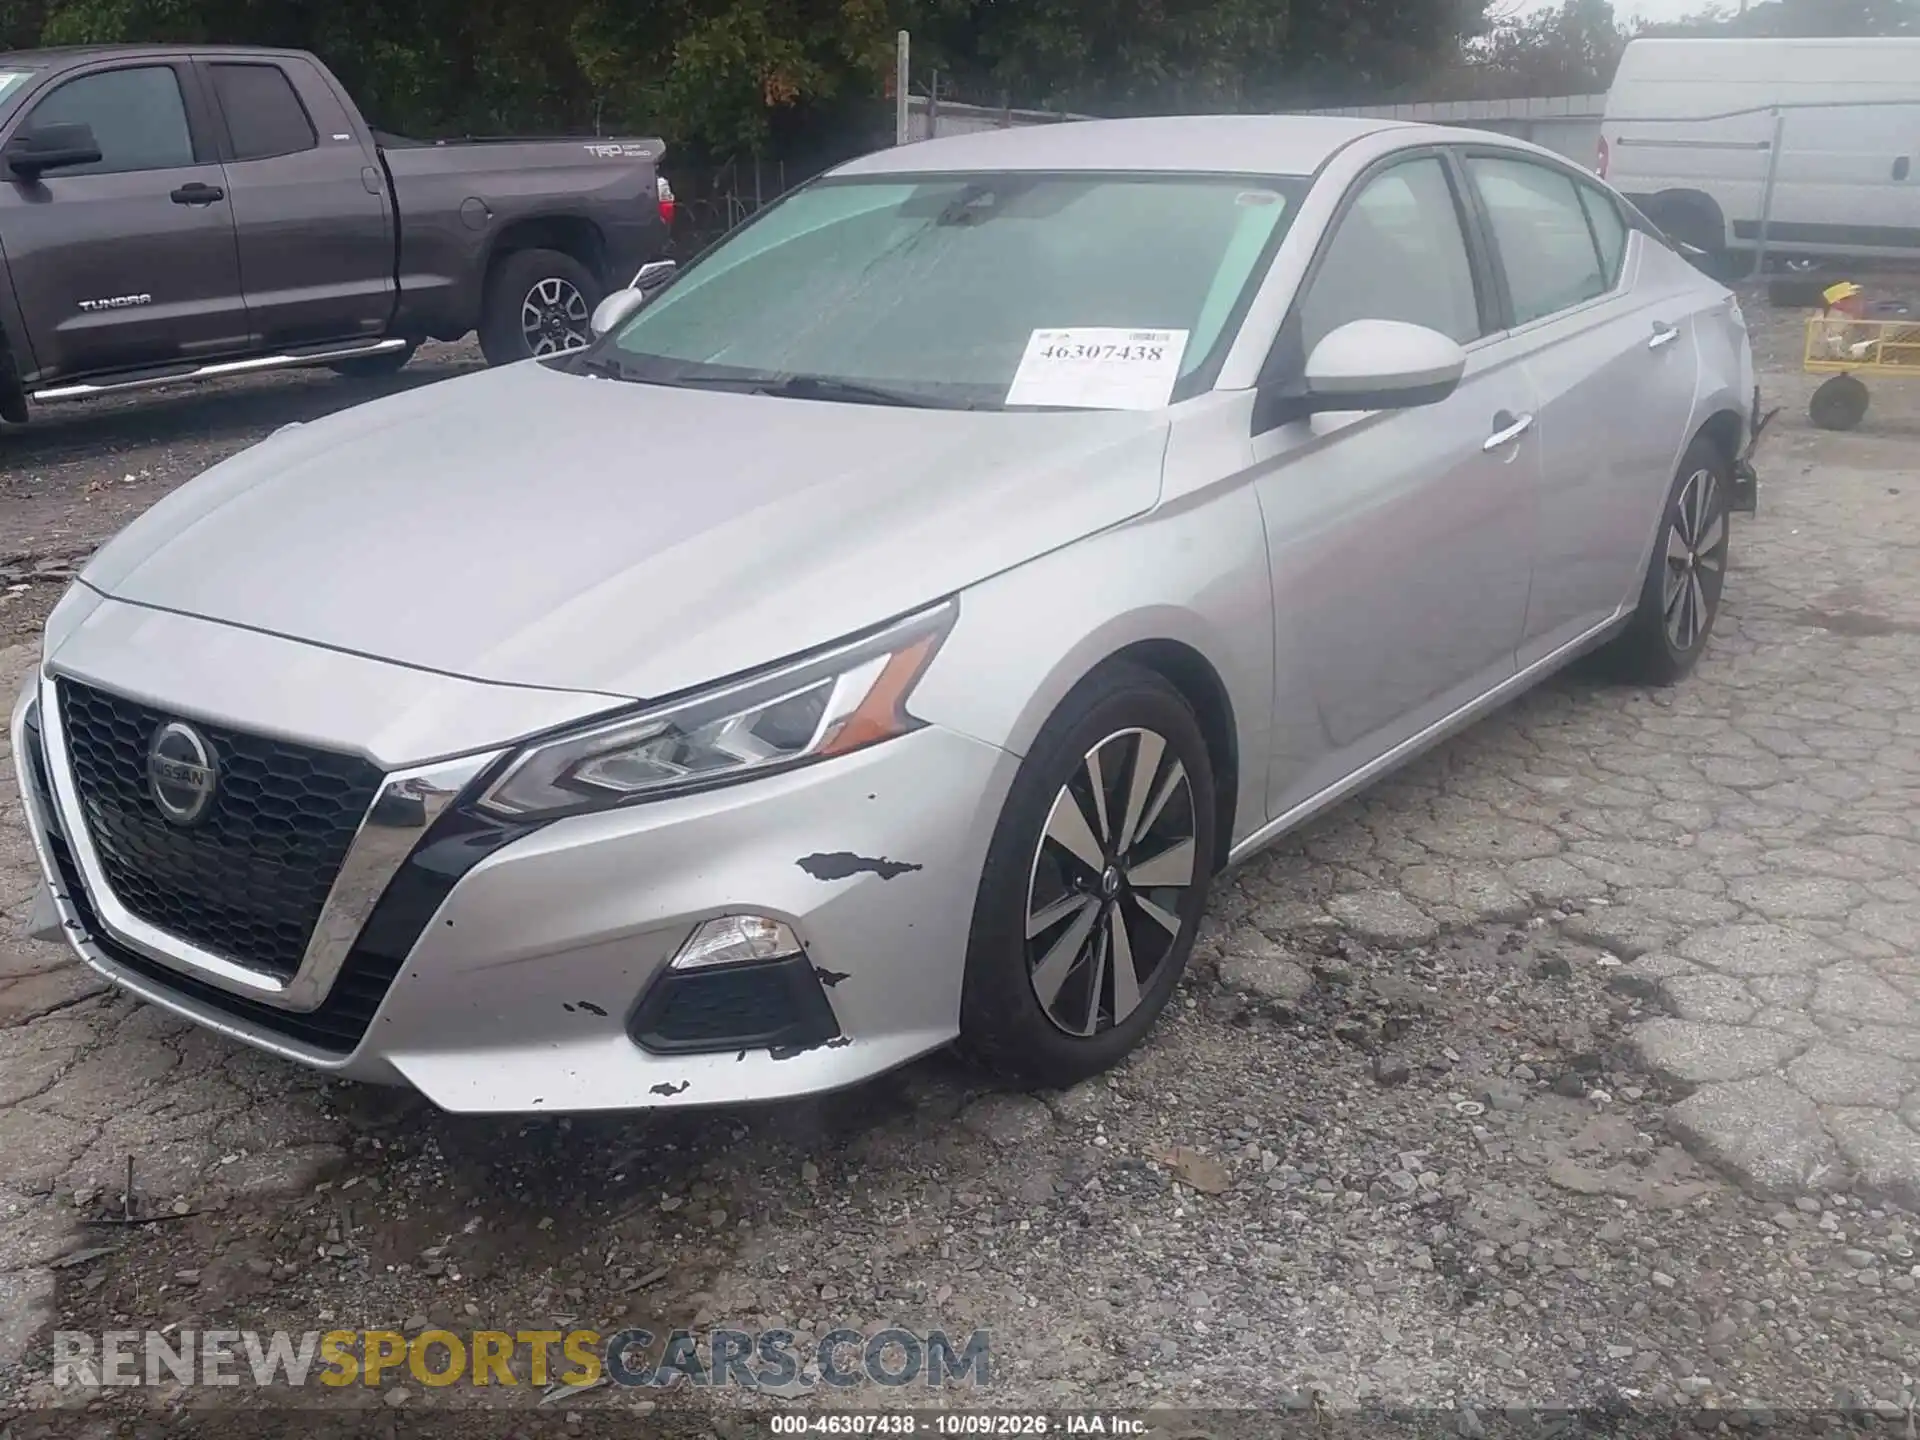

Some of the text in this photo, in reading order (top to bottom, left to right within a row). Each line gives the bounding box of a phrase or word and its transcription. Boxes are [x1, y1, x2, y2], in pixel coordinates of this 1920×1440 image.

[584, 144, 622, 158] TRD
[78, 293, 152, 311] TUNDRA
[1040, 344, 1164, 361] 46307438
[153, 758, 204, 786] NISSAN
